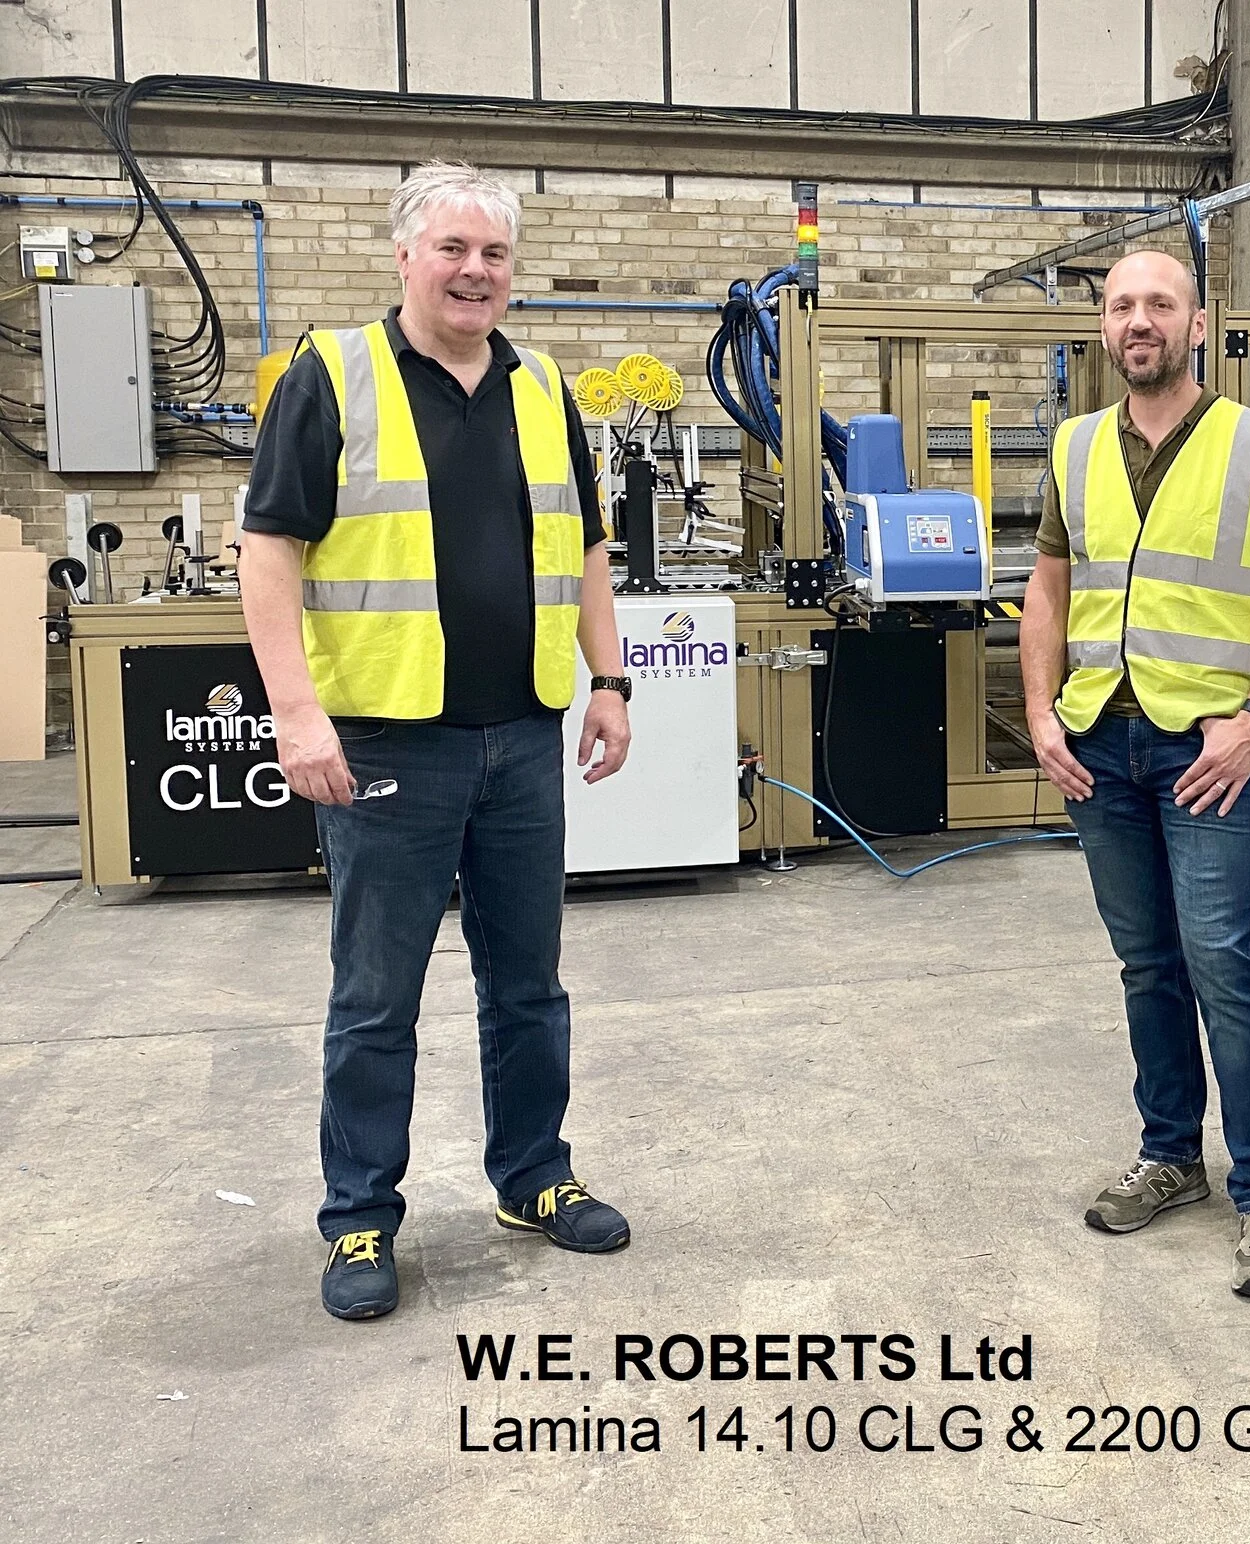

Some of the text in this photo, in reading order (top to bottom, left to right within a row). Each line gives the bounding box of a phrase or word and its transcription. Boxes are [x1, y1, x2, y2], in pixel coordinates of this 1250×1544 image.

[622, 636, 728, 668] lamina
[640, 668, 711, 679] SYSTEM
[165, 709, 277, 741] lamina
[185, 741, 261, 752] SYSTEM
[159, 761, 291, 811] CLG
